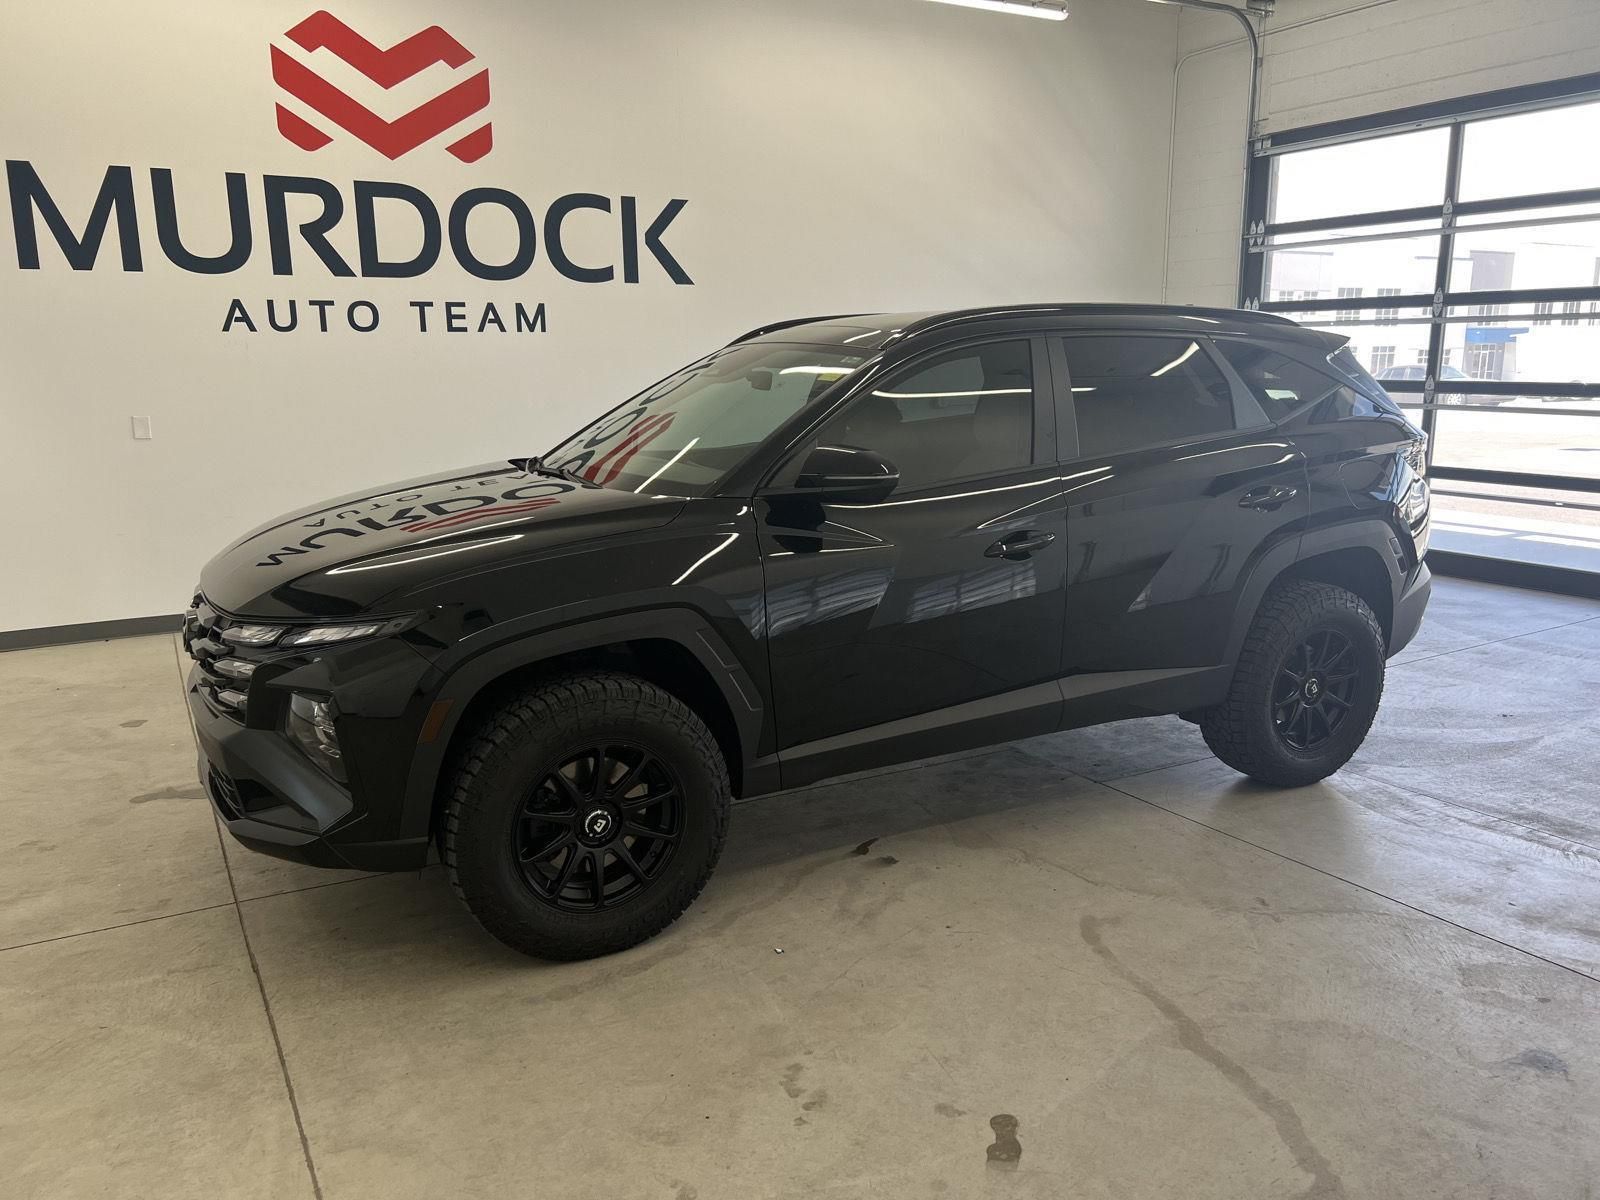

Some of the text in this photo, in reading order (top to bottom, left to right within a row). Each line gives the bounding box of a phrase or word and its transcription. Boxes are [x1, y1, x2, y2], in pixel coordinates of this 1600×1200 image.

[6, 159, 695, 286] MURDOCK
[222, 298, 548, 333] AUTO TEAM
